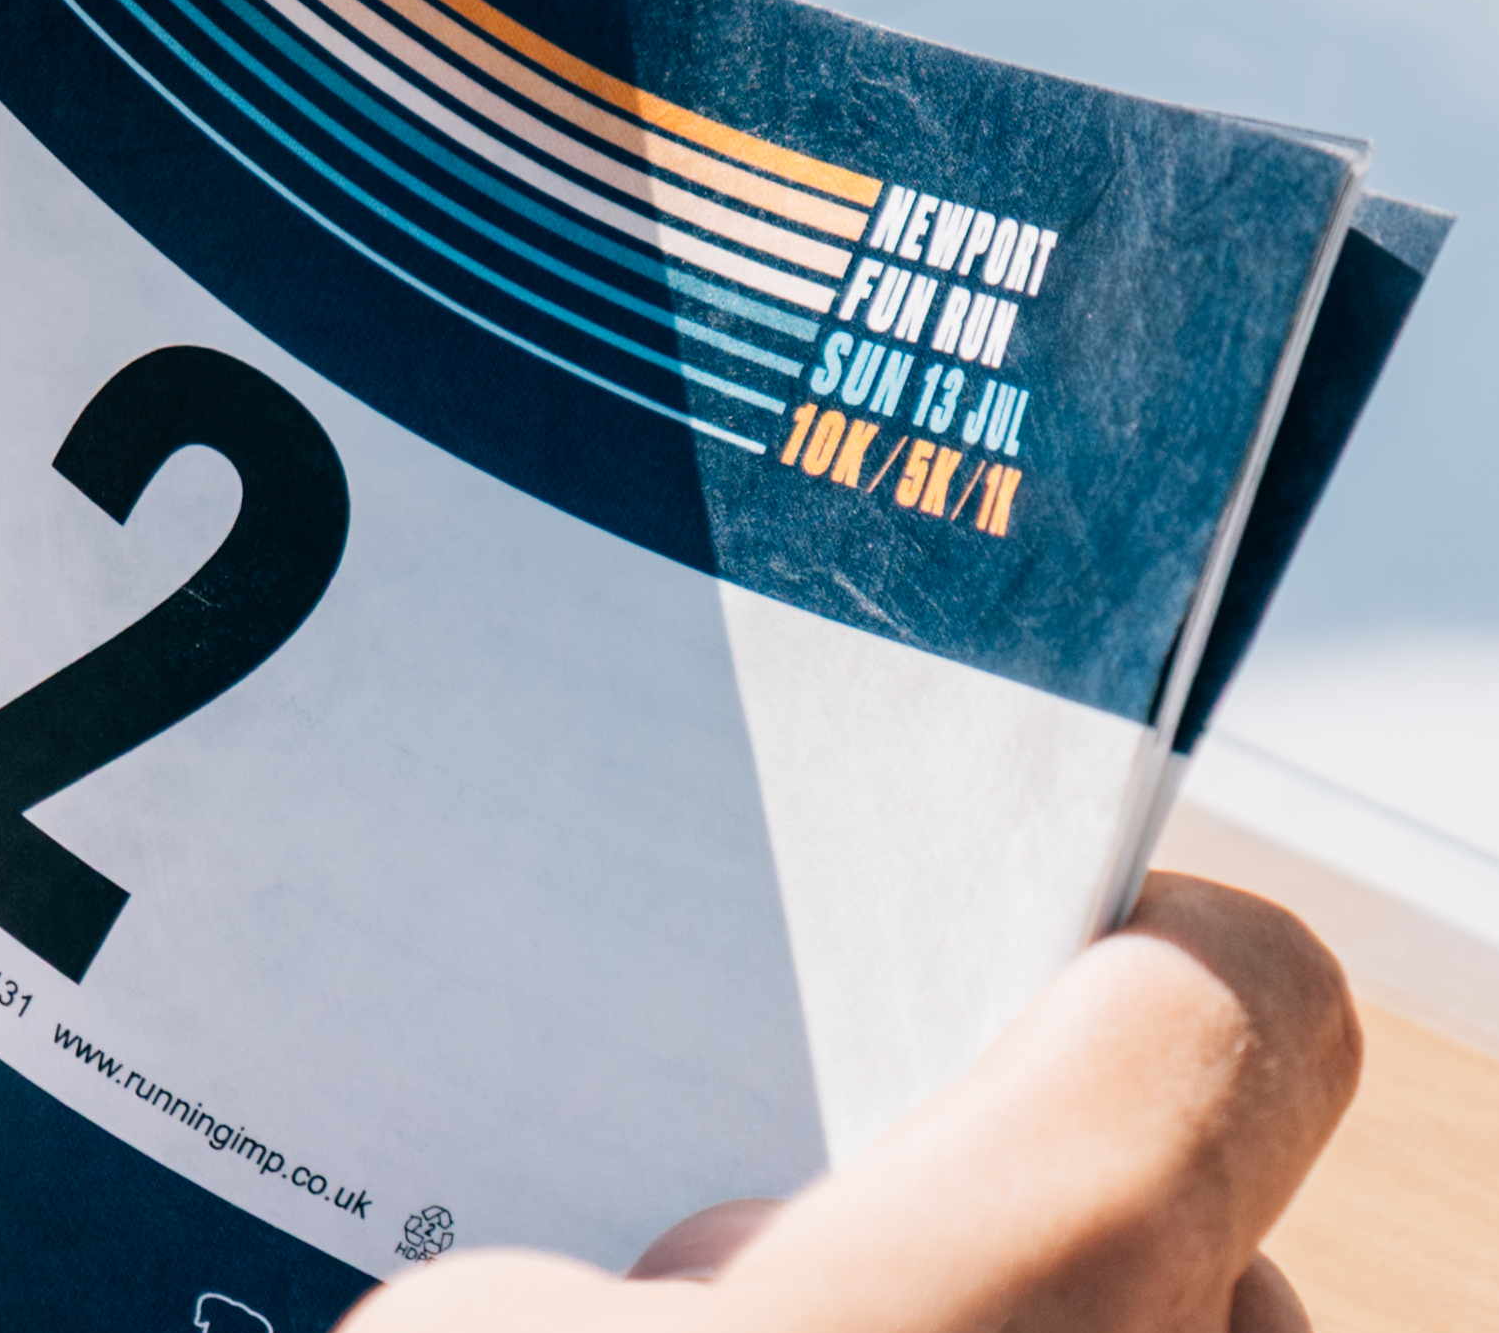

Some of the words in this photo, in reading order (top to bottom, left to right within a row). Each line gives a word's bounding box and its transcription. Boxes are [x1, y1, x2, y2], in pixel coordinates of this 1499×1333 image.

[869, 184, 1058, 297] NEWPORT
[838, 257, 939, 344] FUN
[931, 284, 1019, 369] RUN
[809, 329, 915, 418] SUN
[912, 363, 966, 435] 13
[962, 378, 1030, 457] JUL
[780, 401, 880, 489] 10K
[895, 438, 963, 517] 5K
[975, 463, 1022, 538] 1K
[52, 1022, 374, 1221] www.runningimp.co.uk
